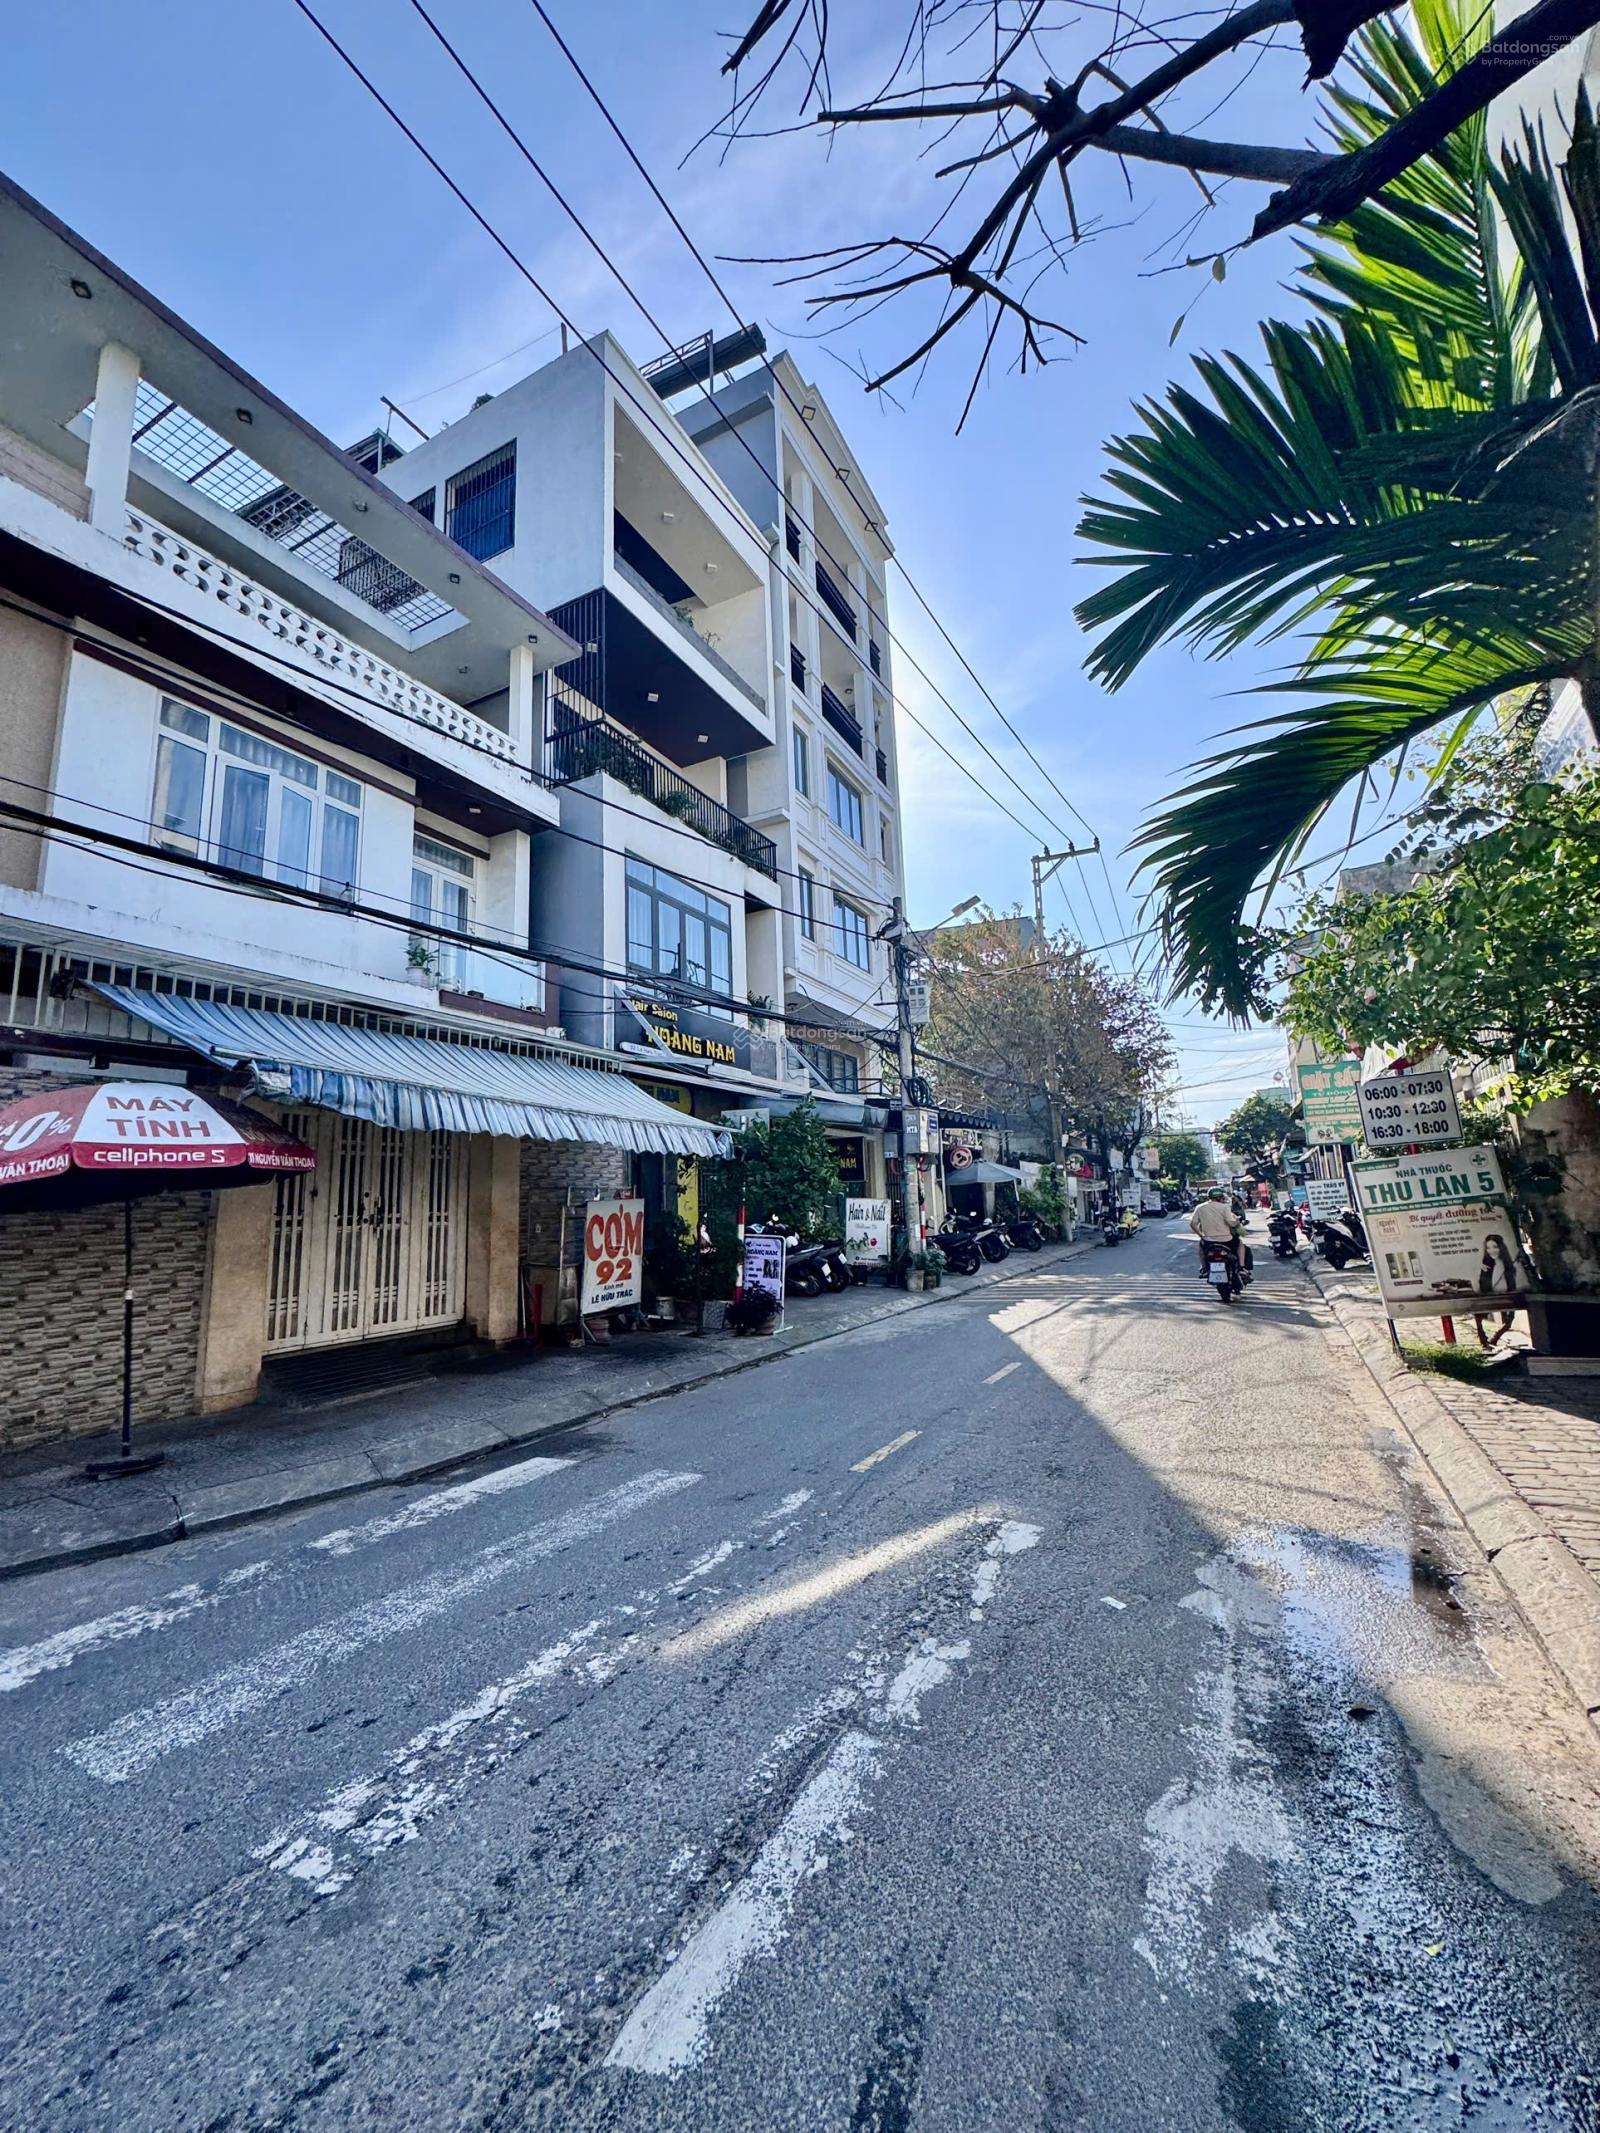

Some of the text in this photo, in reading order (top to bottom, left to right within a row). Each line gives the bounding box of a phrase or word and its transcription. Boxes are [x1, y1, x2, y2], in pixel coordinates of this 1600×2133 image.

[706, 1039, 736, 1063] NAM
[1365, 1086, 1398, 1101] 06:00
[1408, 1080, 1443, 1096] 07:30
[106, 1096, 194, 1112] MÁY
[1368, 1105, 1401, 1120] 10:30
[1412, 1100, 1447, 1115] 12:30
[107, 1116, 211, 1137] TÍNH
[1372, 1124, 1403, 1139] 16:30
[1415, 1120, 1449, 1135] 18:00
[28, 1154, 69, 1174] THOẠI
[94, 1148, 205, 1166] cellphone
[1396, 1164, 1453, 1178] NHÀ THUỐC
[1365, 1180, 1414, 1204] THU
[1419, 1174, 1471, 1199] LAN
[1477, 1171, 1495, 1192] 5
[585, 1204, 644, 1262] CƠM
[596, 1258, 632, 1285] 92
